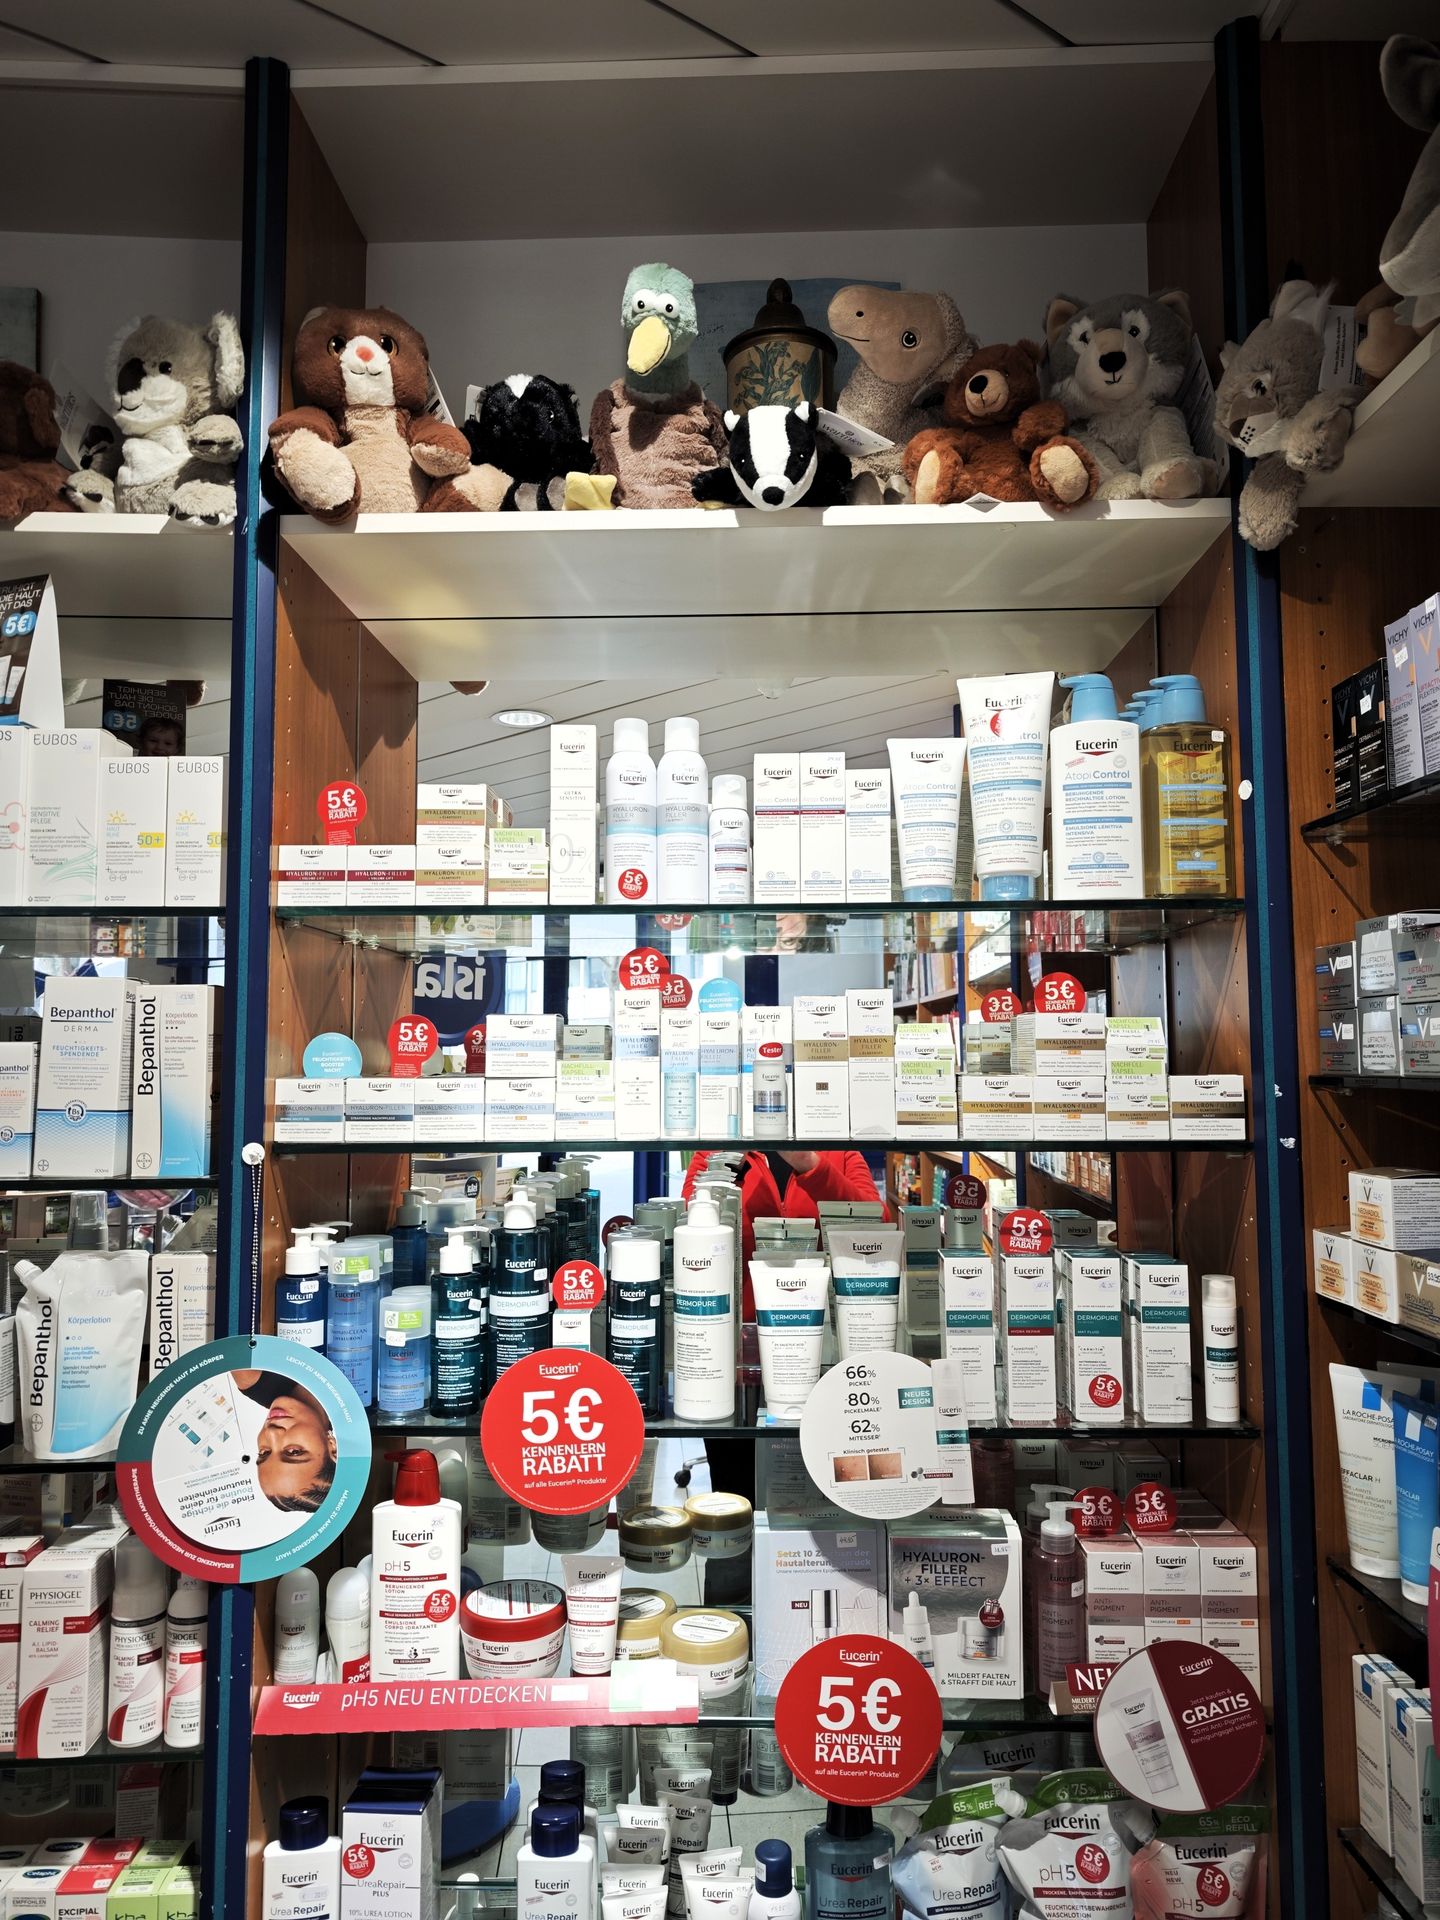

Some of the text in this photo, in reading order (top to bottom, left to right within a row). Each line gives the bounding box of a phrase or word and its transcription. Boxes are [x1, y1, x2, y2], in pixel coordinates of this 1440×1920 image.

[1413, 610, 1436, 629] VICHY
[1387, 627, 1409, 646] VICHY
[33, 734, 77, 746] EUBOS
[560, 743, 586, 751] Eucerin
[1075, 740, 1121, 752] Eucerin
[1174, 740, 1214, 752] Eucerin
[911, 751, 944, 761] Eucerin
[108, 762, 150, 774] EUBOS
[177, 762, 219, 774] EUBOS
[764, 768, 793, 777] Eucerin
[809, 767, 838, 775] Eucerin
[300, 849, 324, 857] Eucerin
[369, 849, 393, 857] Eucerin
[629, 956, 661, 977] 5€
[1045, 981, 1075, 1001] 5€
[624, 999, 651, 1007] Eucerin
[857, 999, 884, 1007] Eucerin
[50, 1007, 116, 1022] Bepanthol
[400, 1023, 429, 1043] 5€
[137, 996, 157, 1096] Bepanthol
[297, 1083, 321, 1092] Eucerin
[368, 1082, 392, 1091] Eucerin
[508, 1082, 533, 1090] Eucerin
[1194, 1079, 1220, 1088] Eucerin
[1012, 1217, 1043, 1238] 5€
[853, 1242, 882, 1252] Eucerin
[1010, 1241, 1042, 1252] RABATT
[505, 1259, 537, 1270] Eucerin
[682, 1257, 712, 1267] Eucerin
[952, 1266, 983, 1276] Eucerin
[1014, 1266, 1045, 1276] Eucerin
[563, 1269, 595, 1290] 5€
[776, 1279, 807, 1289] Eucerin
[1149, 1274, 1181, 1284] Eucerin
[845, 1281, 890, 1290] DERMOPURE
[447, 1289, 474, 1298] Eucerin
[563, 1293, 595, 1302] RABATT
[620, 1288, 647, 1299] Eucerin
[676, 1299, 717, 1309] DERMOPURE
[154, 1267, 174, 1369] Bepanthol
[771, 1312, 811, 1322] DERMOPURE
[949, 1314, 991, 1322] DERMOPURE
[1010, 1313, 1053, 1322] DERMOPURE
[1077, 1314, 1119, 1322] DERMOPURE
[1145, 1309, 1188, 1319] DERMOPURE
[30, 1296, 52, 1407] Bepanthol
[539, 1364, 579, 1377] Eucerin
[904, 1390, 931, 1399] NEUES
[901, 1397, 932, 1407] DESIGN
[522, 1442, 606, 1460] KENNENLERN
[522, 1455, 606, 1478] RABATT
[177, 1478, 253, 1503] Hautunreinheiten
[231, 1493, 255, 1505] Finde
[1134, 1490, 1167, 1514] 5€
[179, 1499, 204, 1511] deine
[204, 1517, 242, 1536] Eucerin
[1081, 1519, 1113, 1529] RABATT
[1136, 1515, 1168, 1527] RABATT
[392, 1530, 435, 1543] Eucerin
[803, 1550, 813, 1558] 10
[902, 1551, 987, 1565] HYALURON-
[1155, 1555, 1187, 1566] Eucerin
[1212, 1557, 1245, 1567] Eucerin
[920, 1564, 968, 1577] FILLER
[1100, 1561, 1132, 1572] Eucerin
[578, 1571, 607, 1581] Eucerin
[933, 1576, 987, 1589] EFFECT
[29, 1590, 82, 1602] PHYSIOGEL
[430, 1593, 451, 1607] 5€
[1093, 1605, 1126, 1613] PIGMENT
[1149, 1606, 1183, 1615] PIGMENT
[1207, 1607, 1241, 1616] PIGMENT
[29, 1619, 60, 1628] CALMING
[280, 1623, 306, 1634] Eucerin
[36, 1625, 60, 1634] RELIEF
[114, 1631, 157, 1644] PHYSIOGEL
[1179, 1658, 1214, 1676] Eucerin
[348, 1672, 367, 1684] 20%
[948, 1672, 1011, 1681] MILDERT FALTEN
[947, 1679, 980, 1687] STRAFFT
[282, 1692, 321, 1706] Eucerin
[384, 1688, 429, 1708] NEU
[430, 1685, 548, 1706] ENTDECKEN
[1181, 1692, 1251, 1727] GRATIS
[815, 1732, 902, 1748] KENNENLERN
[815, 1745, 902, 1767] RABATT
[668, 1779, 697, 1790] Eucerin
[953, 1801, 974, 1814] 65%
[1043, 1813, 1101, 1832] Eucerin
[1230, 1815, 1251, 1824] ECO
[1225, 1823, 1258, 1833] REFILL
[360, 1832, 405, 1848] Eucerin
[618, 1838, 648, 1850] Eucerin
[934, 1828, 984, 1850] Eucerin
[1174, 1843, 1229, 1862] Eucerin
[831, 1863, 874, 1877] Eucerin
[282, 1872, 319, 1885] Eucerin
[535, 1879, 571, 1891] Eucerin
[372, 1890, 390, 1899] PLUS
[702, 1888, 734, 1901] Eucerin
[58, 1907, 100, 1917] EXCIPIAL
[364, 1909, 383, 1918] UREA
